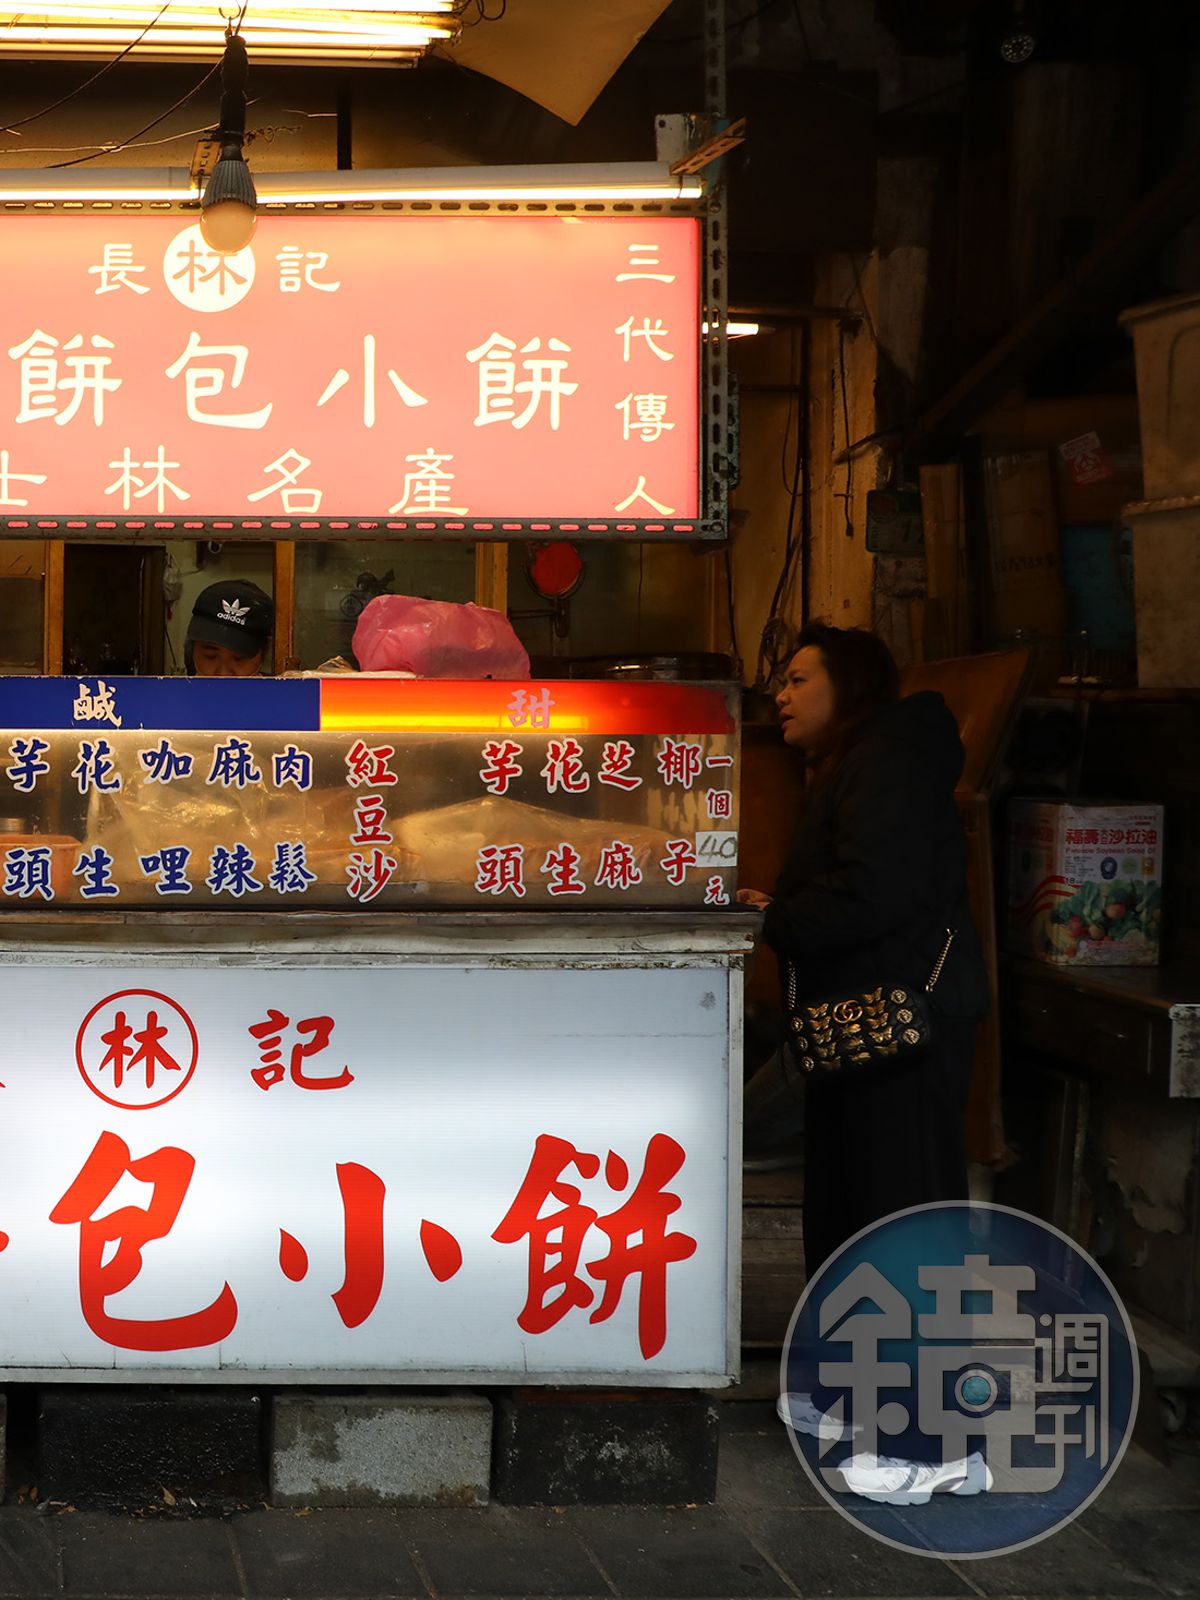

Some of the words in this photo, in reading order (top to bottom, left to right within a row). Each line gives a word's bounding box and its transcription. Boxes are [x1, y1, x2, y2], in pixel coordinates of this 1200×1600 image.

[614, 243, 677, 516] 三代傳人
[216, 612, 246, 626] adidas
[72, 681, 122, 728] 鹹
[506, 687, 556, 730] 甜
[5, 738, 54, 897] 芋頭
[75, 740, 119, 896] 花生
[140, 741, 194, 894] 咖哩
[208, 738, 260, 896] 麻辣
[269, 747, 316, 892] 肉鬆
[347, 742, 396, 900] 紅豆沙
[478, 742, 524, 895] 芋頭
[543, 740, 587, 893] 花生
[597, 741, 641, 889] 芝麻
[660, 740, 701, 885] 椰子
